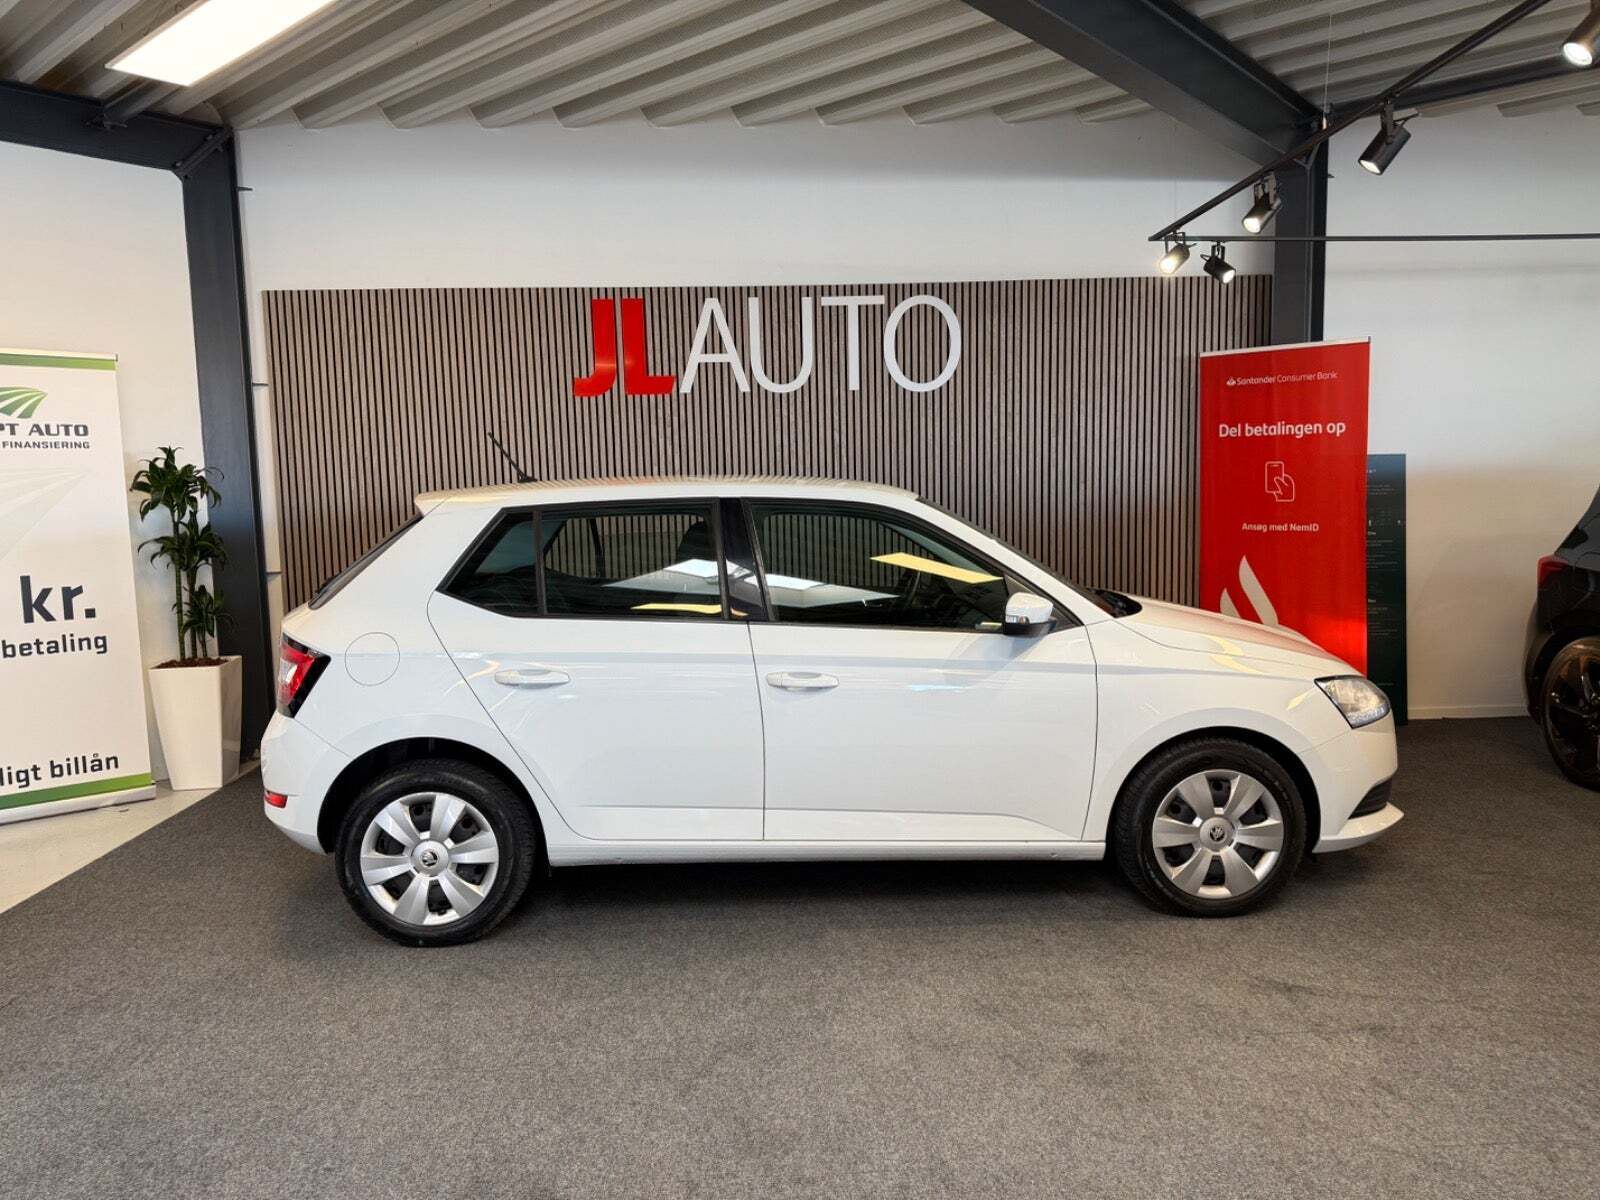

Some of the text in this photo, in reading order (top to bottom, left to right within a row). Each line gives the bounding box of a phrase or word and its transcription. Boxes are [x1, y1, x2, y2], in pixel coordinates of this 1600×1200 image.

[1236, 370, 1338, 386] Santander Consumer Bank
[28, 423, 89, 437] AUTO
[1219, 421, 1346, 439] Del betalingen op
[2, 440, 90, 449] FINANSIERING
[1242, 522, 1319, 533] Ansøg med NemID
[20, 575, 96, 624] kr.
[1, 633, 108, 659] betaling
[49, 752, 119, 778] billån
